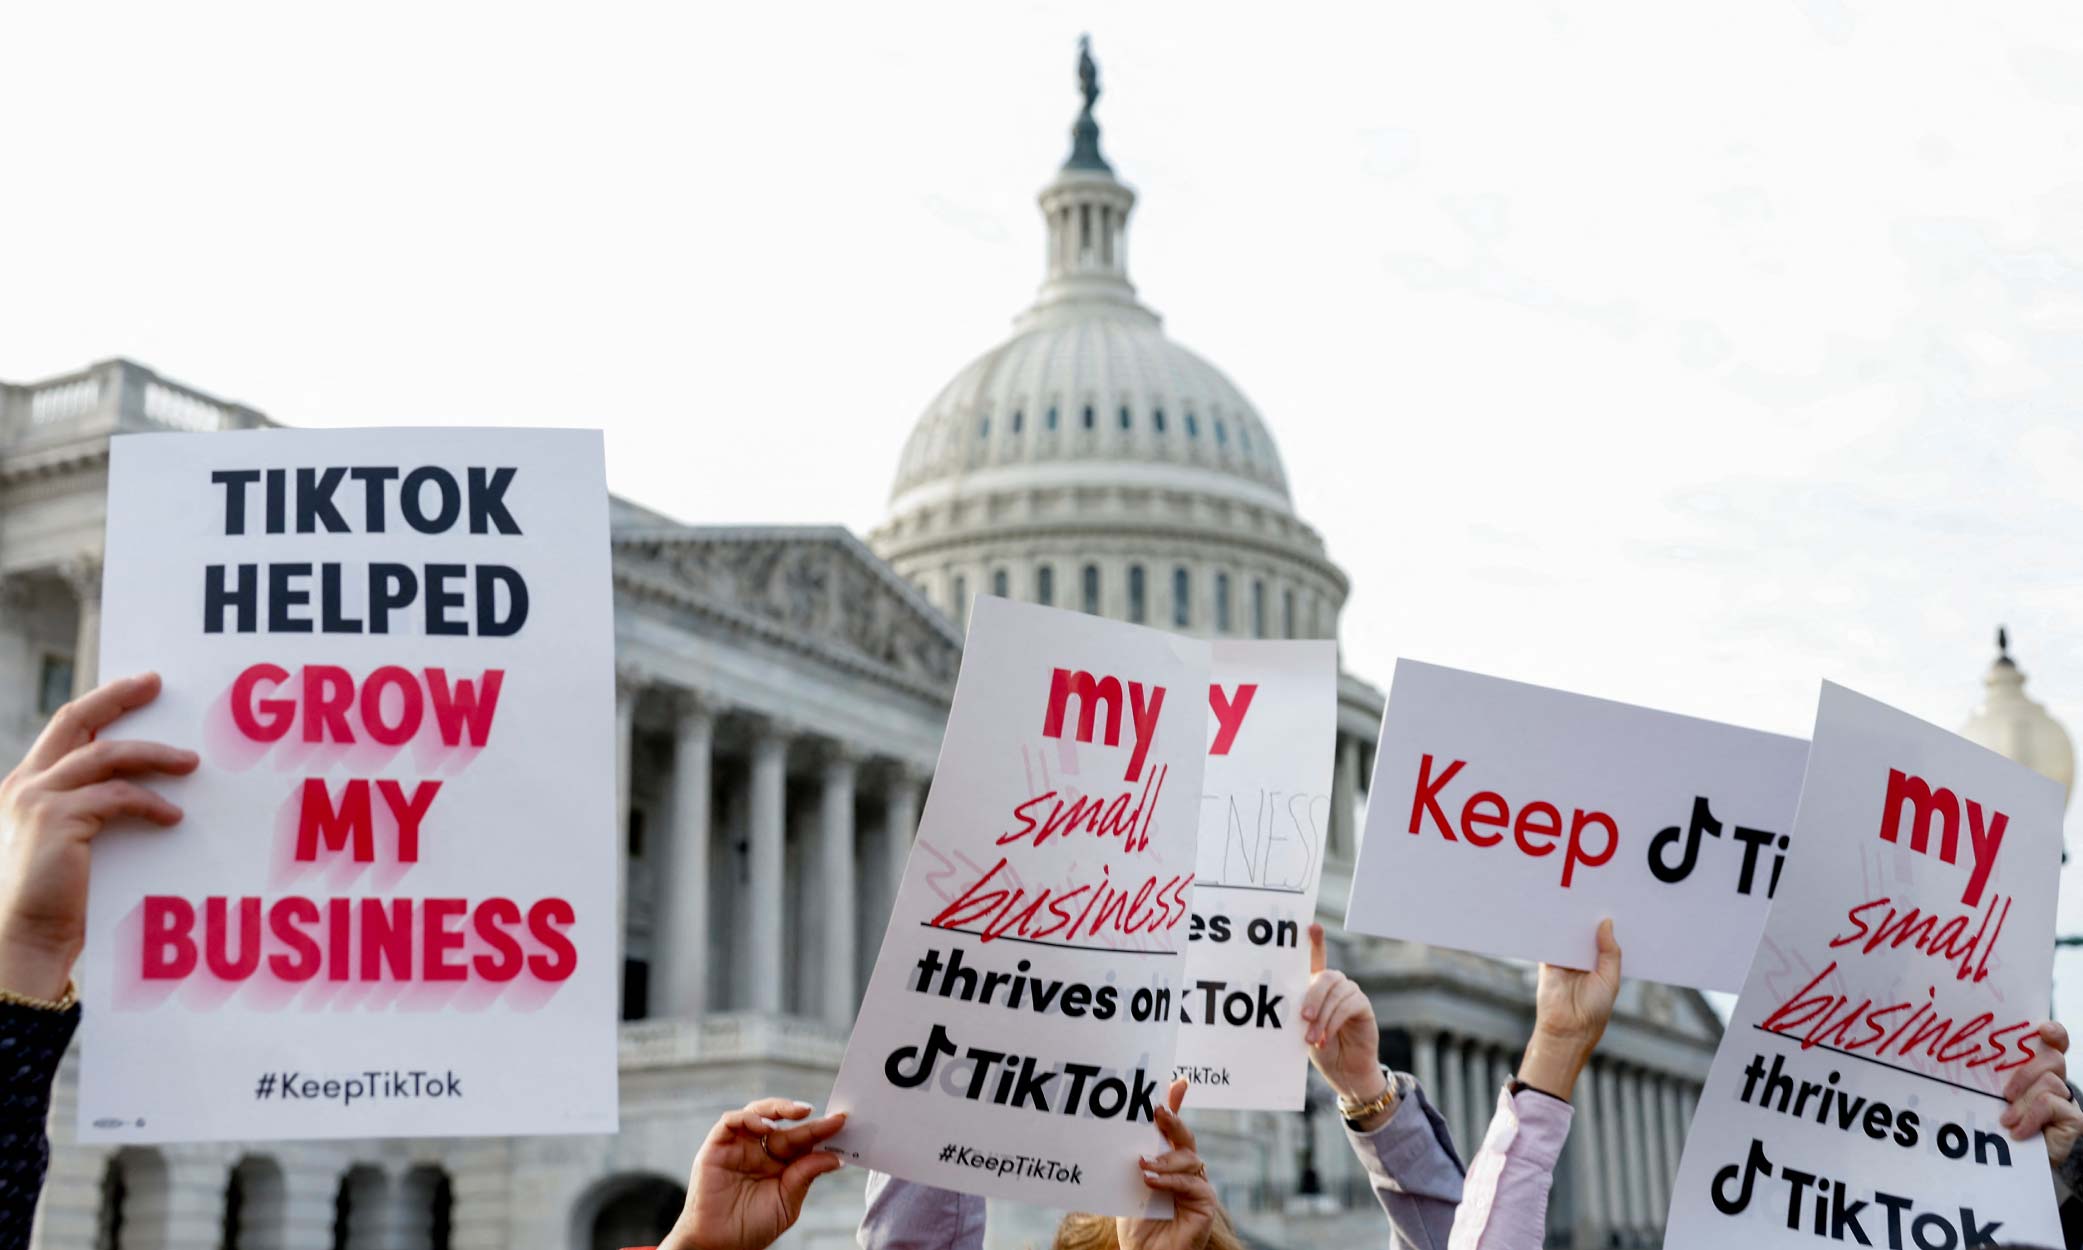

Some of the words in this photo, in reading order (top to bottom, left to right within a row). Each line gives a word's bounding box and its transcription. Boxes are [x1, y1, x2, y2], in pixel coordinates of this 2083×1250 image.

[211, 466, 523, 535] TIKTOK
[203, 563, 529, 637] HELPED
[230, 663, 505, 747] GROW
[1043, 667, 1167, 783] my
[295, 777, 444, 863] MY
[996, 763, 1169, 853] small
[1408, 753, 1619, 889] Keep
[1879, 767, 2010, 908] my
[141, 895, 578, 982] BUSINESS
[931, 857, 1196, 944] business
[1247, 917, 1299, 948] on
[1829, 893, 2012, 983] small
[915, 948, 1119, 1021] thrives
[1130, 986, 1172, 1023] on
[1761, 961, 2042, 1072] business
[254, 1070, 463, 1106] #KeepTikTok
[965, 1047, 1158, 1123] TikTok
[1740, 1053, 1920, 1148] thrives
[1936, 1121, 2013, 1168] on
[938, 1143, 1083, 1186] #KeepTikTok
[1781, 1166, 2005, 1250] TikTok
